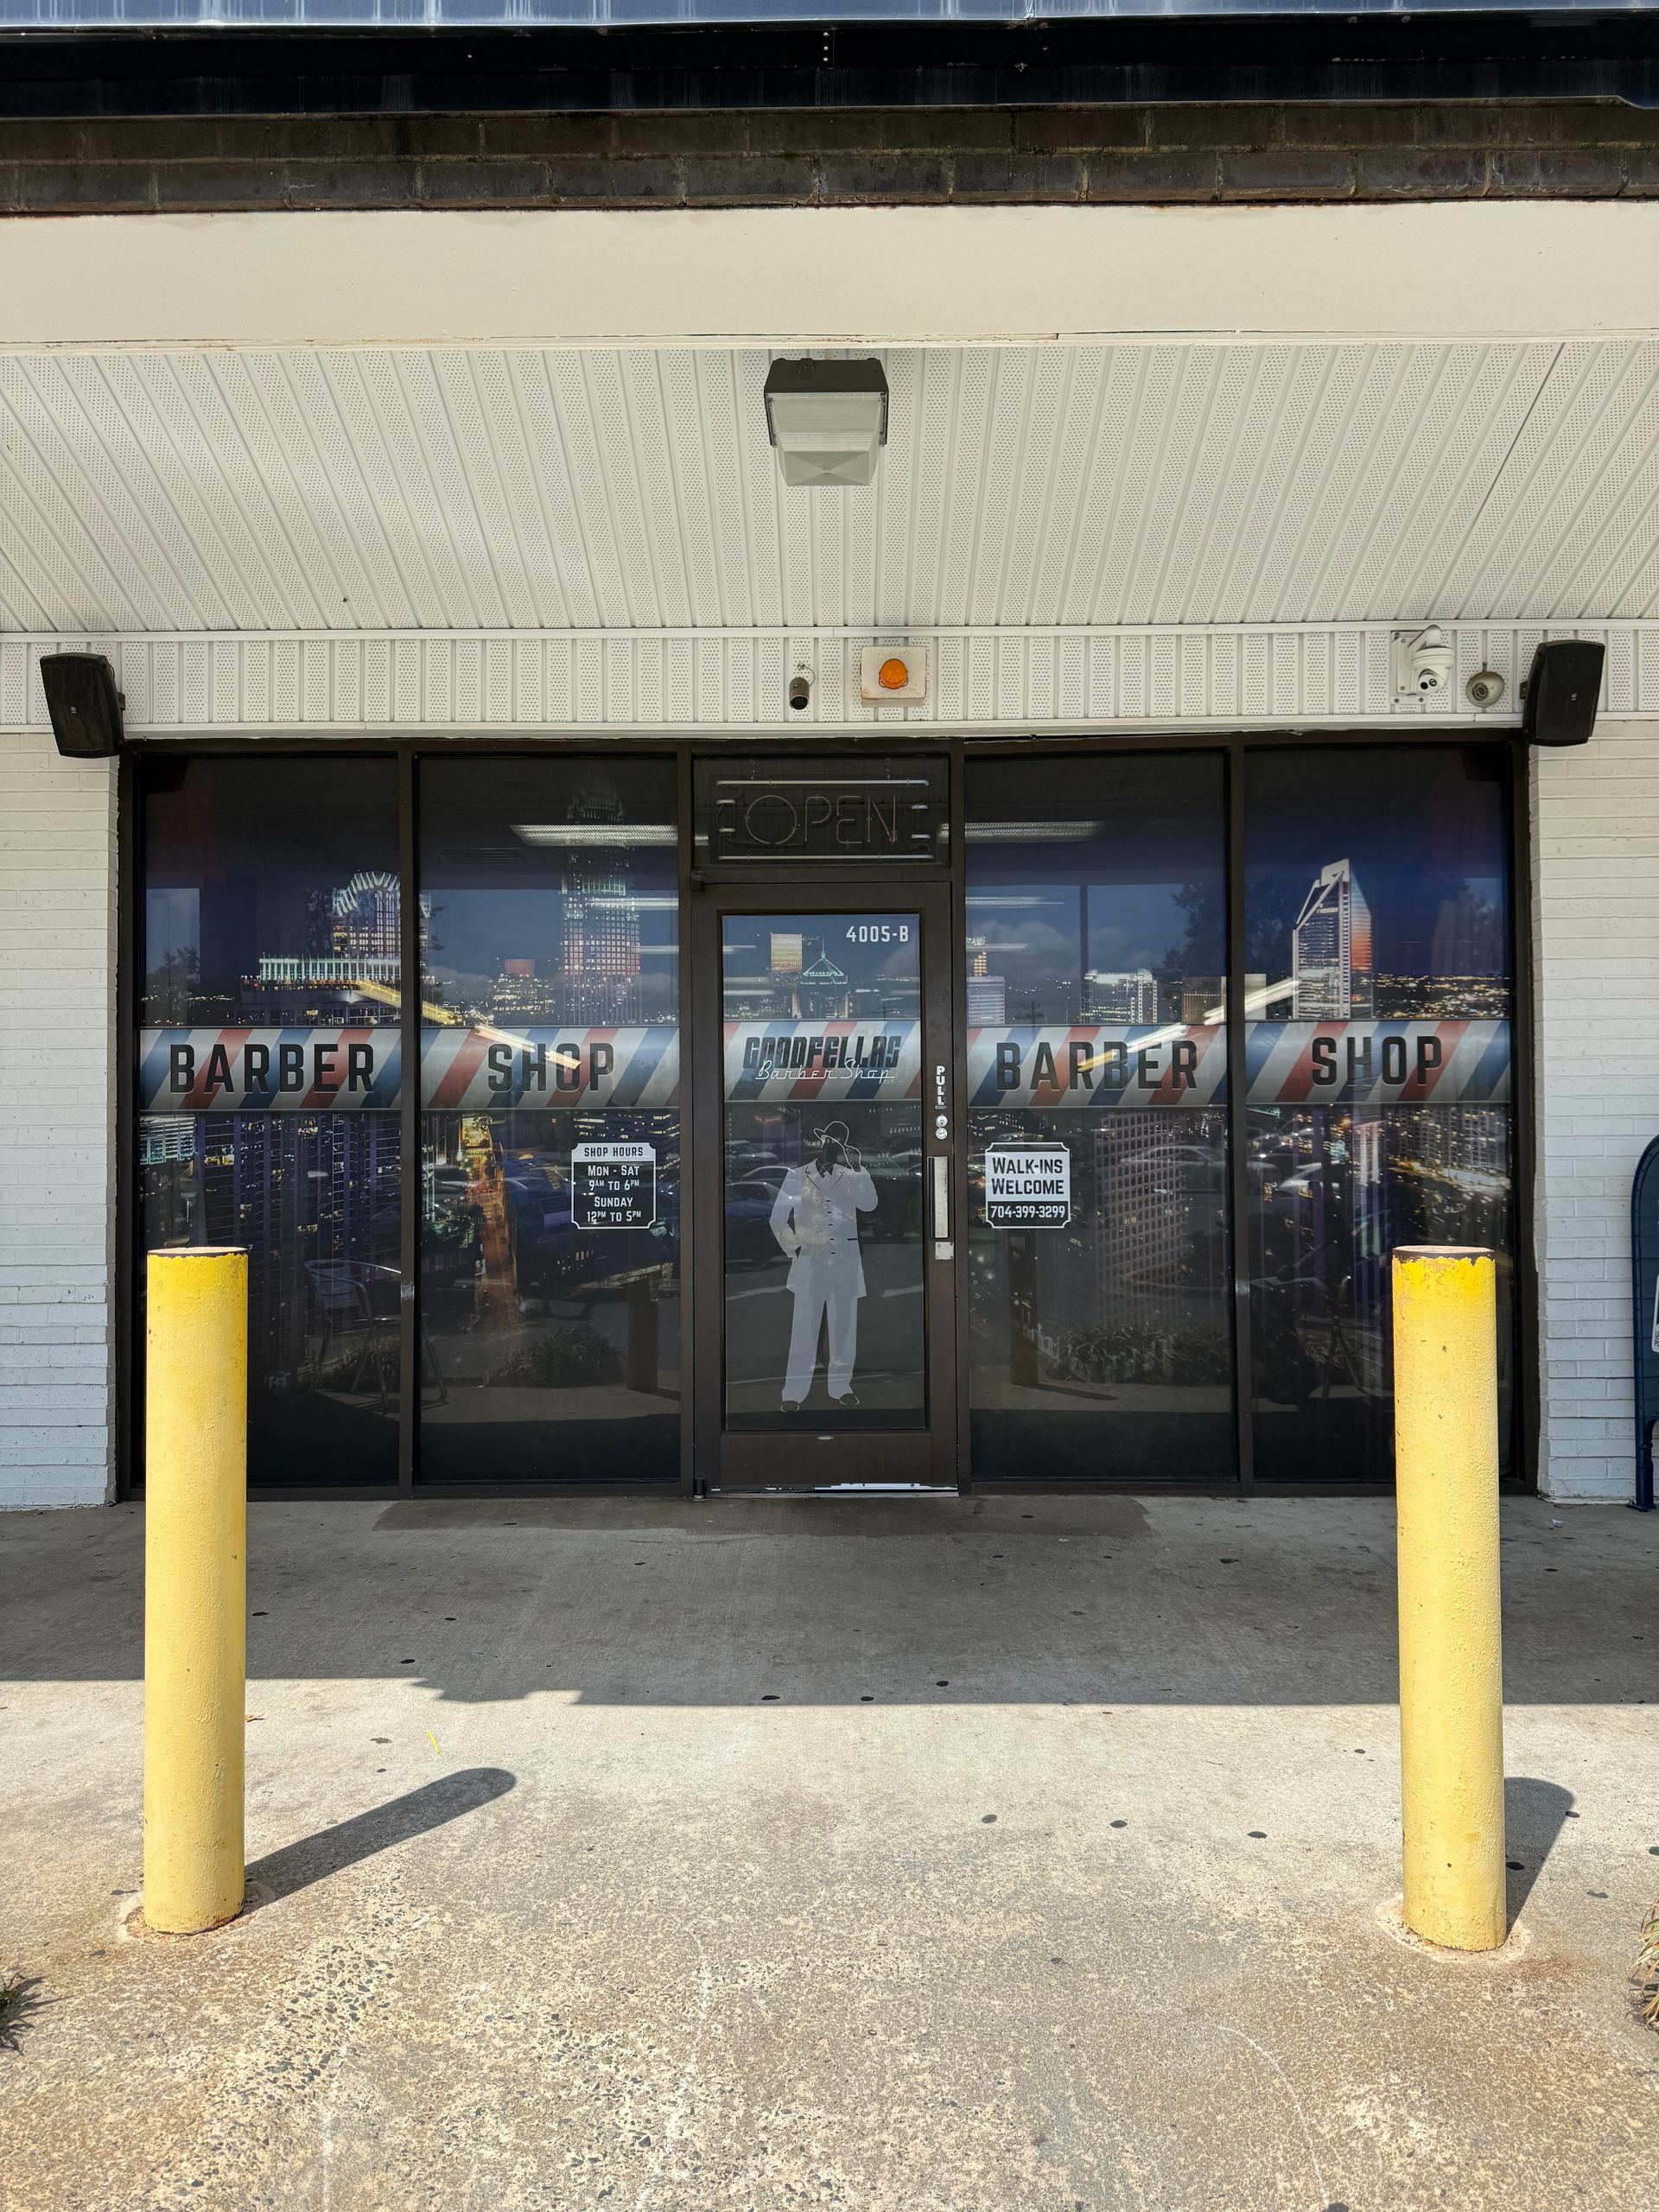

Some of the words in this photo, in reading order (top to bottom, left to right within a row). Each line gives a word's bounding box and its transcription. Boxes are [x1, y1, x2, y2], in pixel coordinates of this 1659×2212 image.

[746, 795, 896, 844] OPEN
[846, 925, 909, 943] 4005-B
[742, 1036, 902, 1069] GOODFELLAS
[169, 1043, 374, 1093] BARBER
[487, 1043, 614, 1092] SHOP
[755, 1059, 838, 1080] Barber
[840, 1057, 896, 1084] Shop
[996, 1039, 1198, 1090] BARBER
[1312, 1035, 1442, 1086] SHOP
[936, 1065, 945, 1105] PULL
[584, 1147, 608, 1157] SHOP
[613, 1147, 644, 1157] HOURS
[588, 1165, 609, 1176] MON
[620, 1165, 640, 1176] SAT
[992, 1157, 1063, 1174] WALK-INS
[588, 1179, 605, 1191] 9AM
[607, 1180, 620, 1191] TO
[624, 1179, 640, 1191] 6PM
[991, 1178, 1065, 1195] WELCOME
[594, 1196, 633, 1207] SUNDAY
[587, 1211, 607, 1222] 12PM
[610, 1212, 622, 1222] TO
[626, 1211, 642, 1222] 5PM
[990, 1205, 1065, 1218] 704-399-3299
